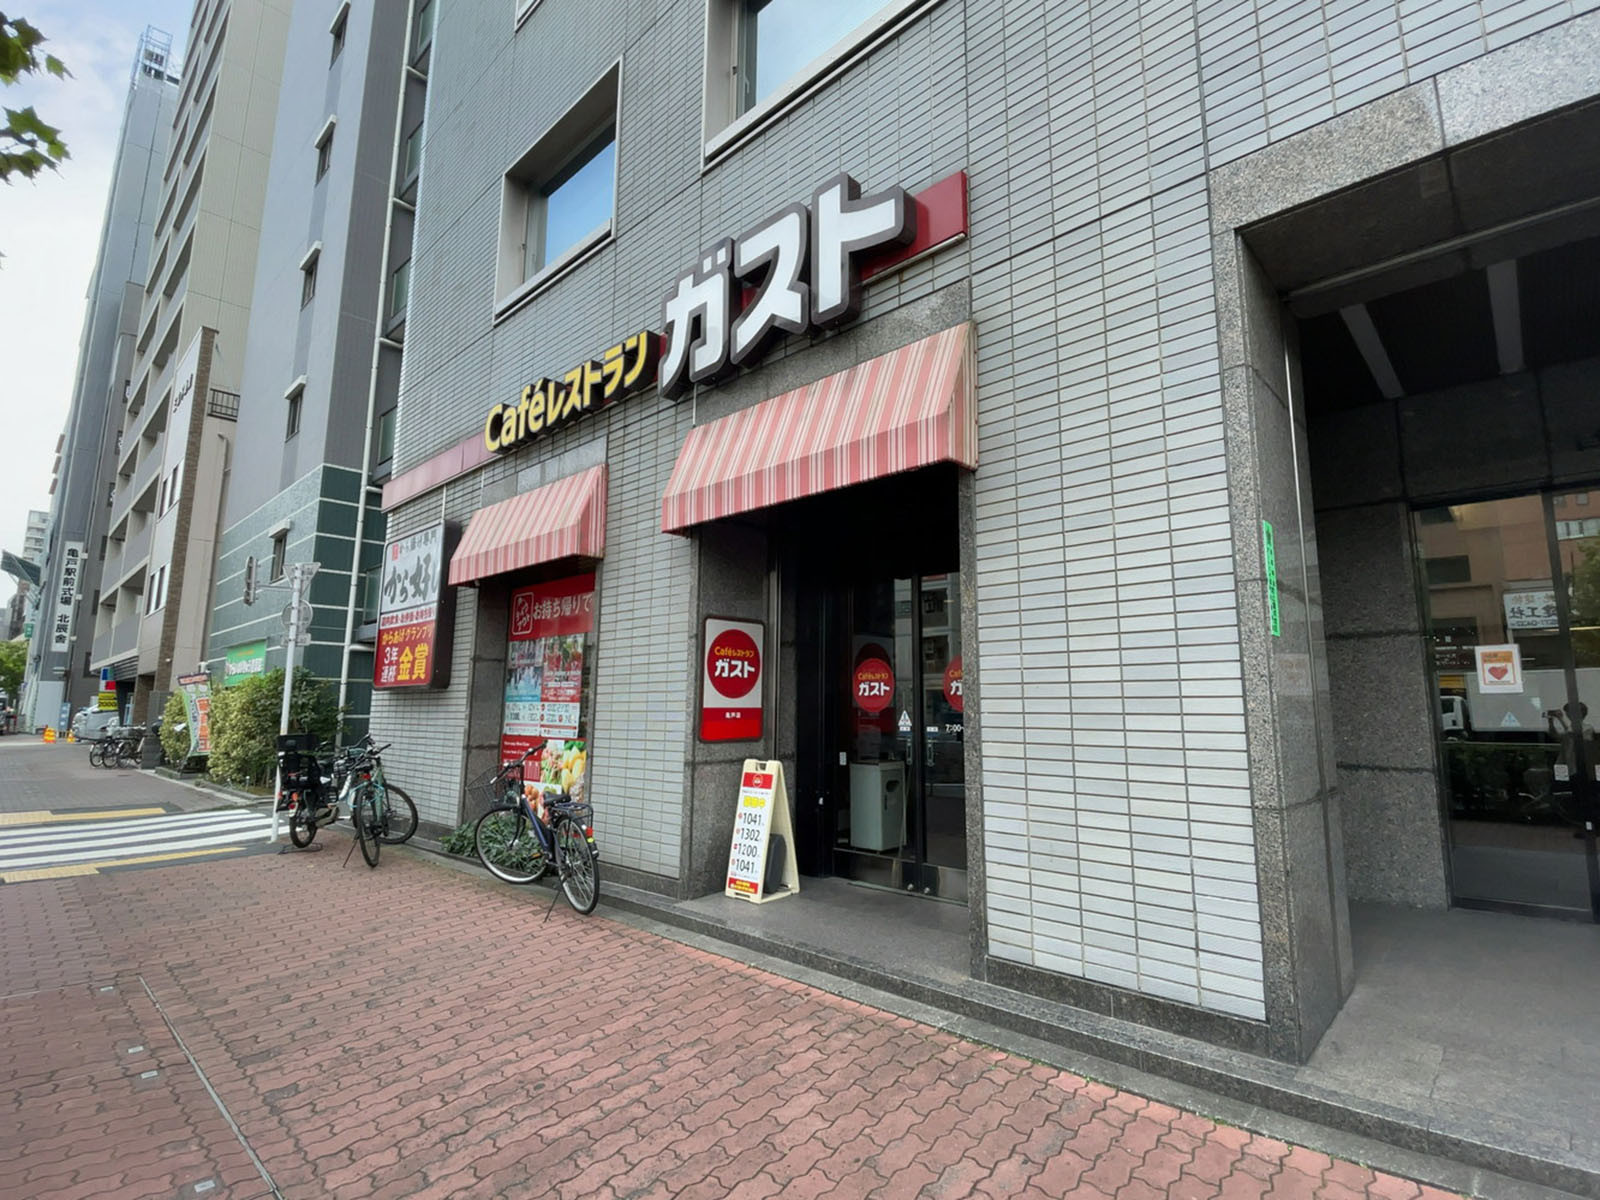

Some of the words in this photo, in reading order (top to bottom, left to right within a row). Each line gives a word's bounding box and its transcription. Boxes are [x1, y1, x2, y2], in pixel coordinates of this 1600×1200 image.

[484, 331, 649, 453] Caféレストラン
[658, 174, 907, 398] ガスト
[60, 547, 80, 606] 亀戸駅前式場
[397, 642, 429, 681] 金賞
[714, 658, 755, 679] ガスト
[859, 682, 890, 696] ガスト
[743, 812, 762, 826] 1041
[740, 827, 761, 842] 1302
[737, 843, 758, 858] 1200
[735, 858, 755, 874] 1041
